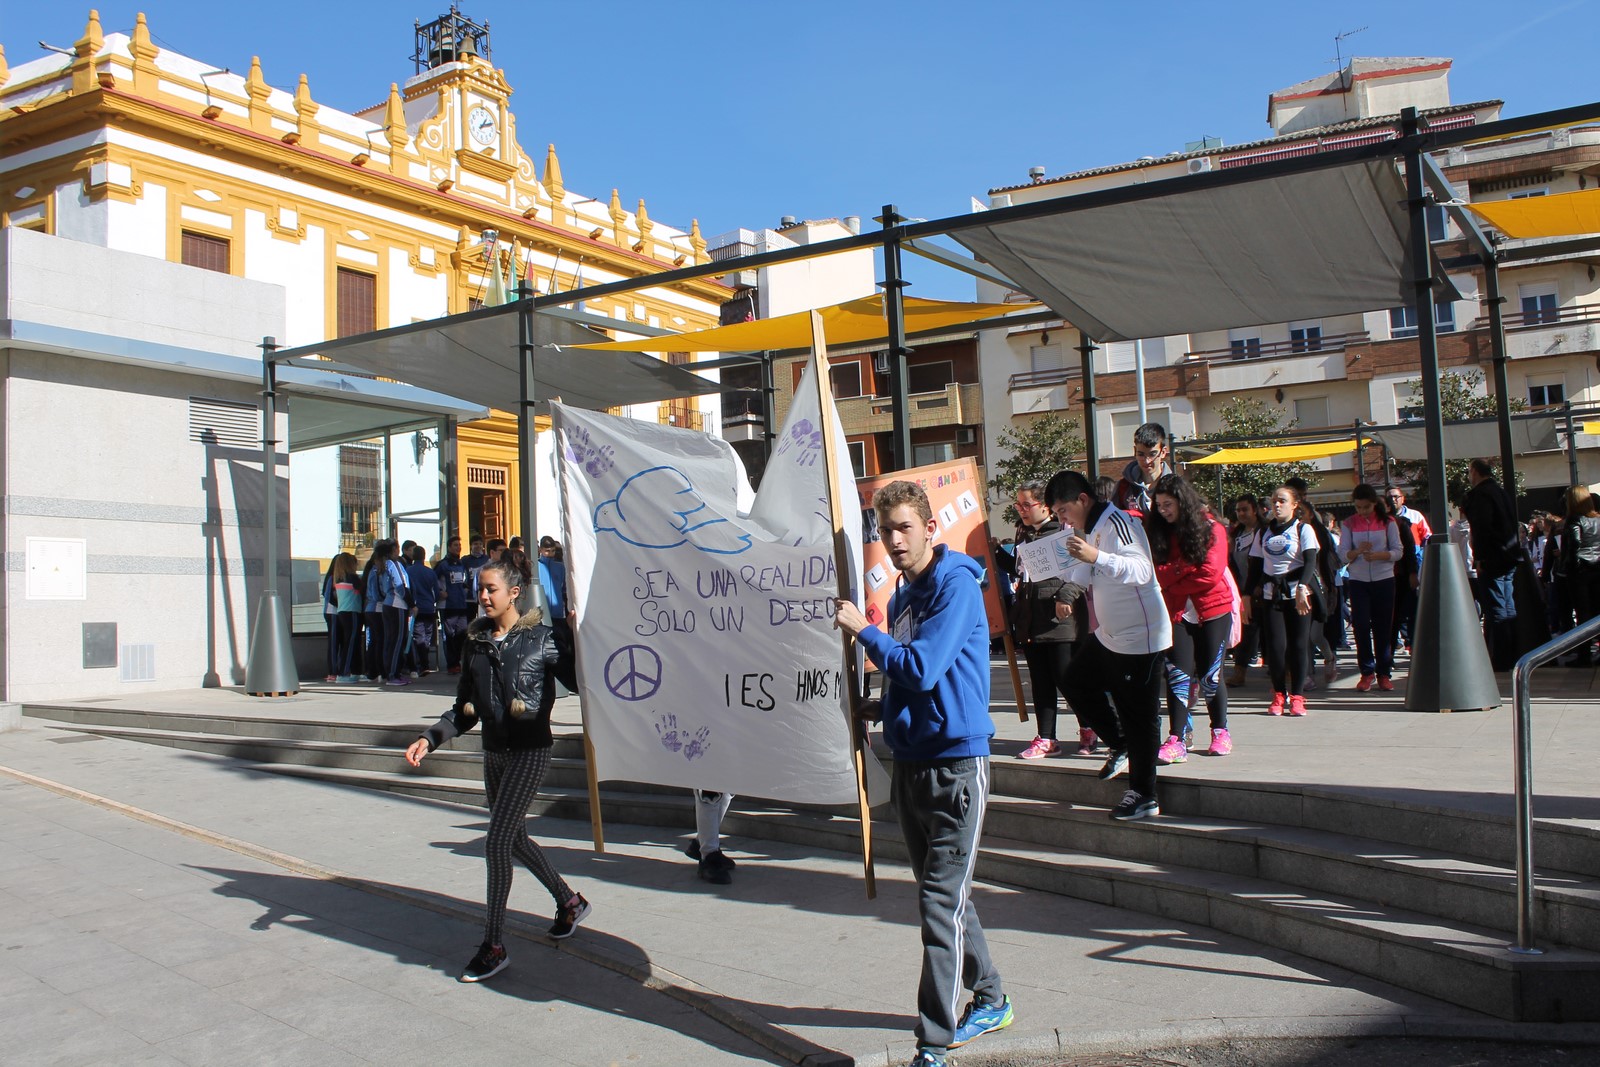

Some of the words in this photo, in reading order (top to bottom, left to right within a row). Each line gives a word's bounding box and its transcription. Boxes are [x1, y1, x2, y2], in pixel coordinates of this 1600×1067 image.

[632, 566, 680, 600] SEA
[696, 567, 738, 599] UNA
[634, 600, 696, 636] SOLO
[709, 606, 744, 633] UN
[769, 596, 836, 627] DESEO
[795, 668, 830, 702] HNOS
